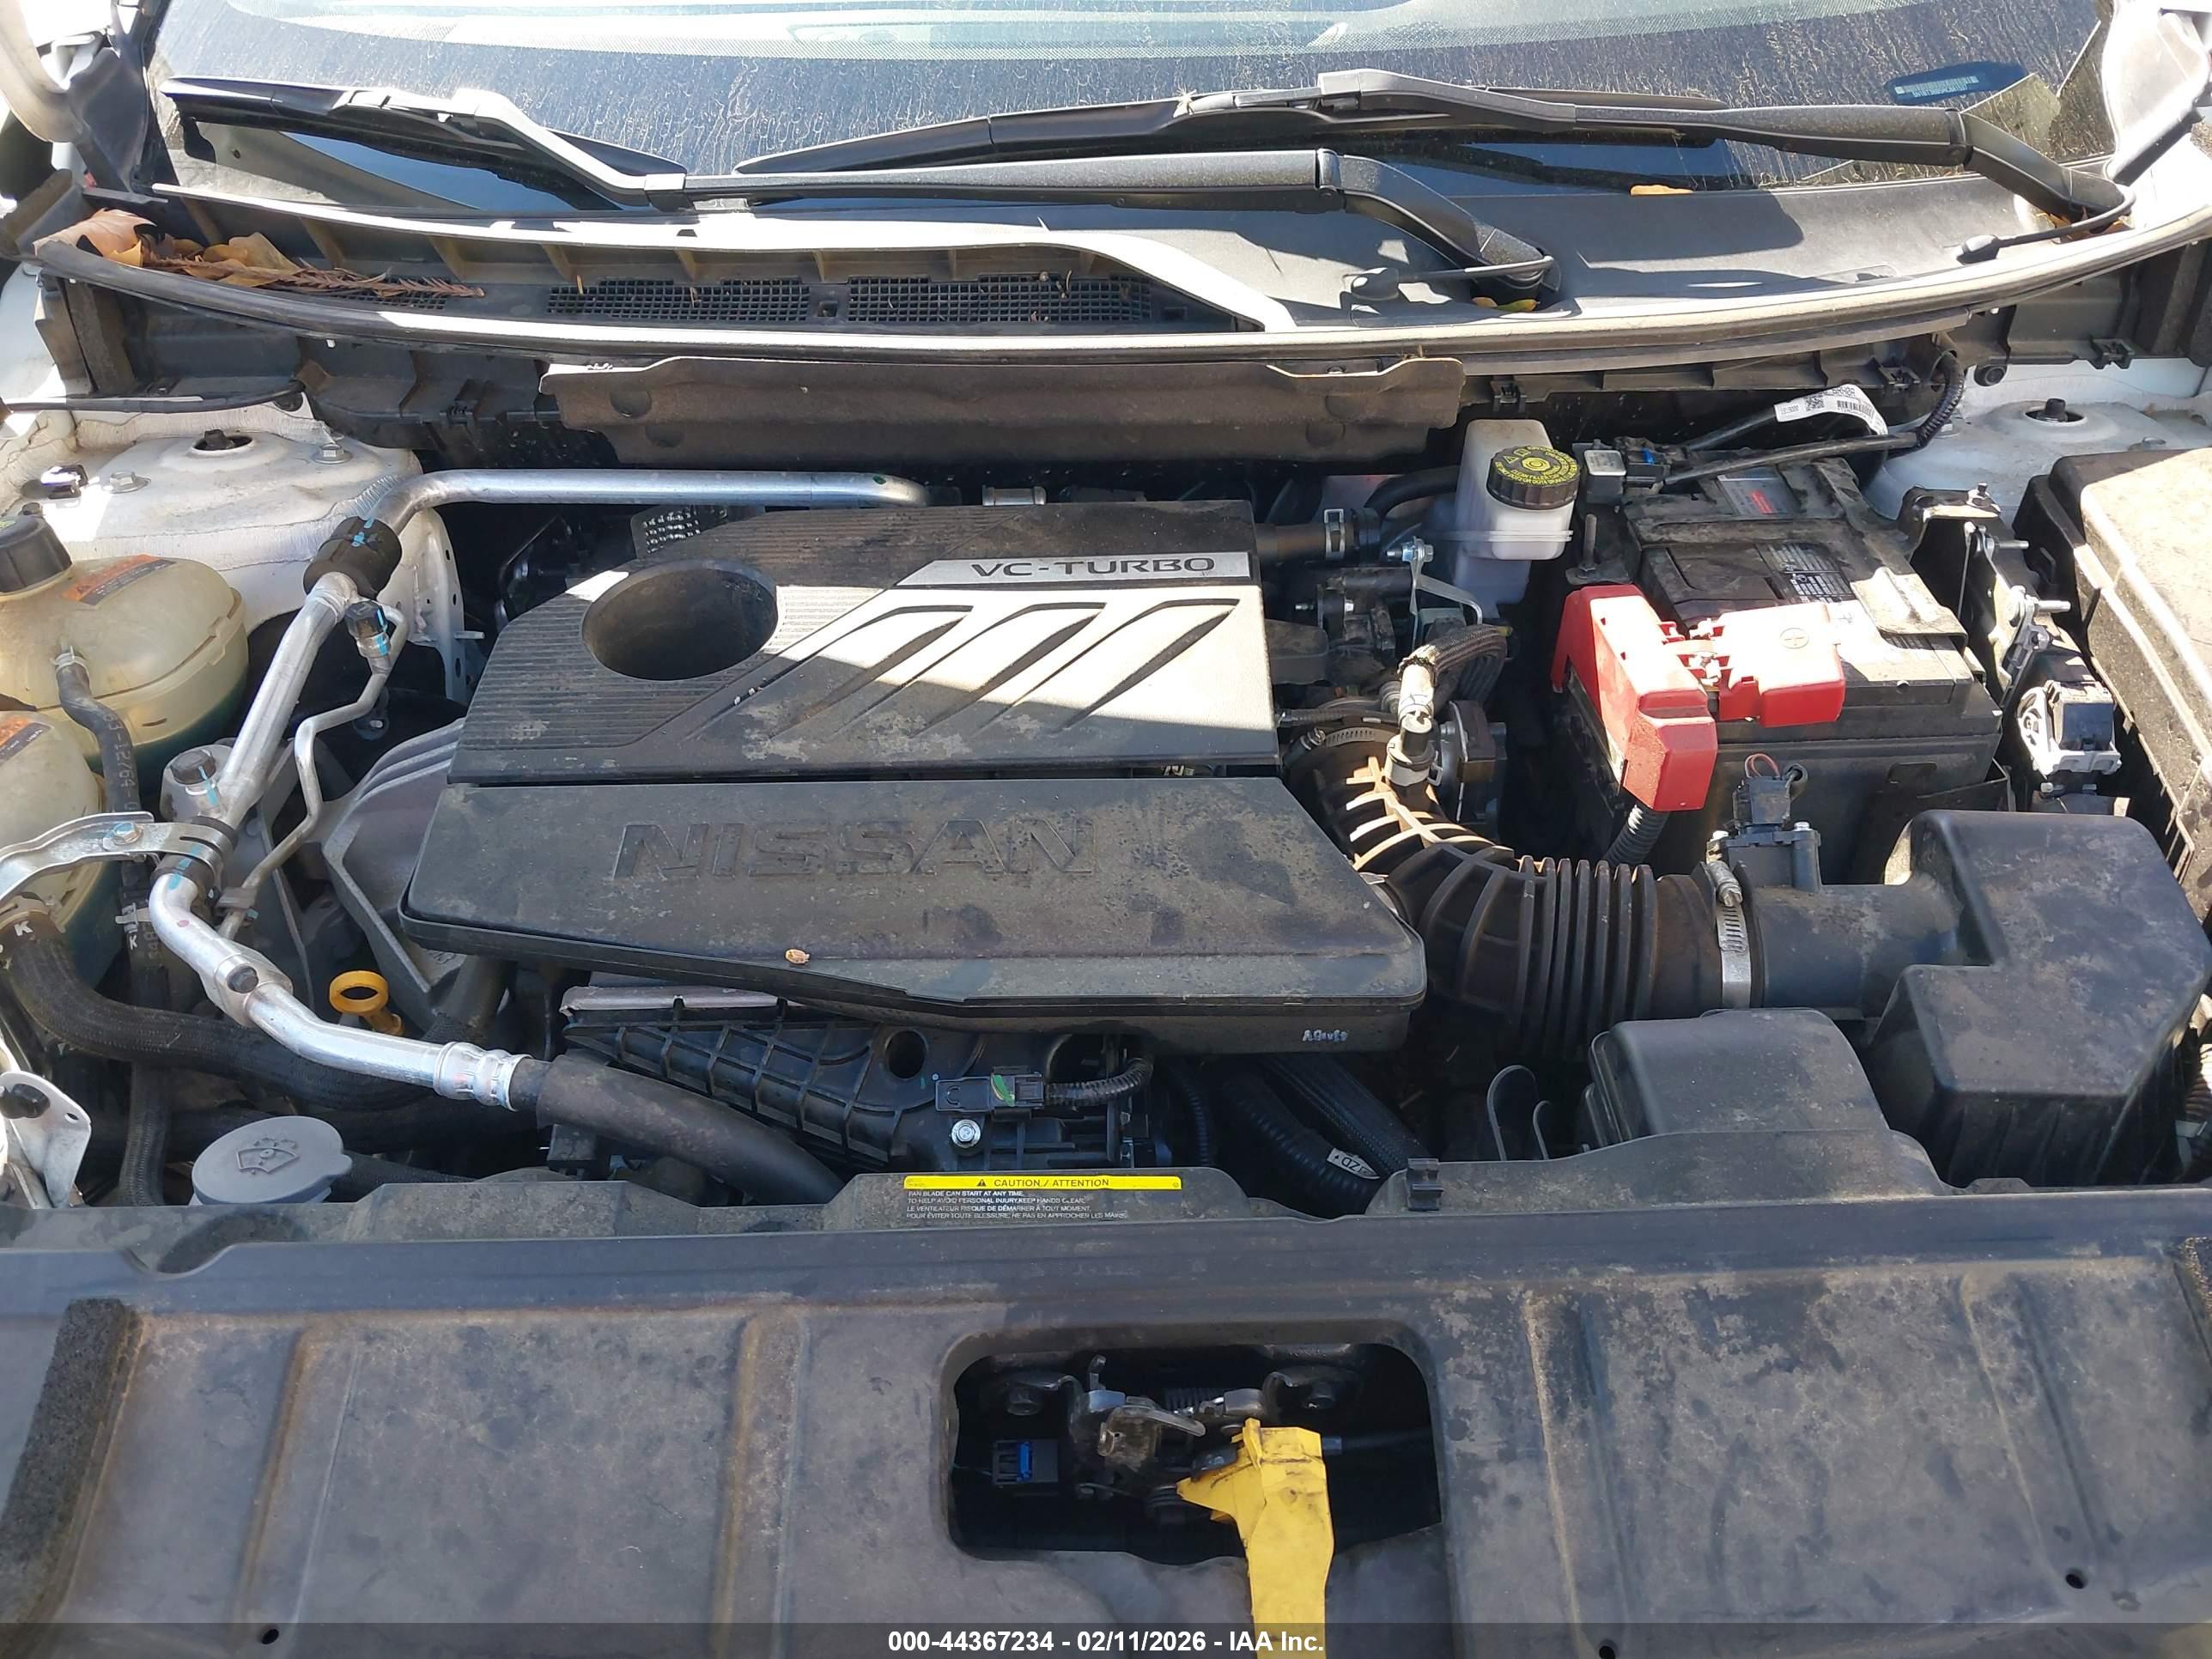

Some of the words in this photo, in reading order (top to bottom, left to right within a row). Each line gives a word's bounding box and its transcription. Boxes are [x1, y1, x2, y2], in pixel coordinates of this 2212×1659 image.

[970, 557, 1215, 577] VC-TURBO
[612, 819, 1094, 880] NISSAN
[14, 921, 33, 936] K
[129, 934, 138, 951] K
